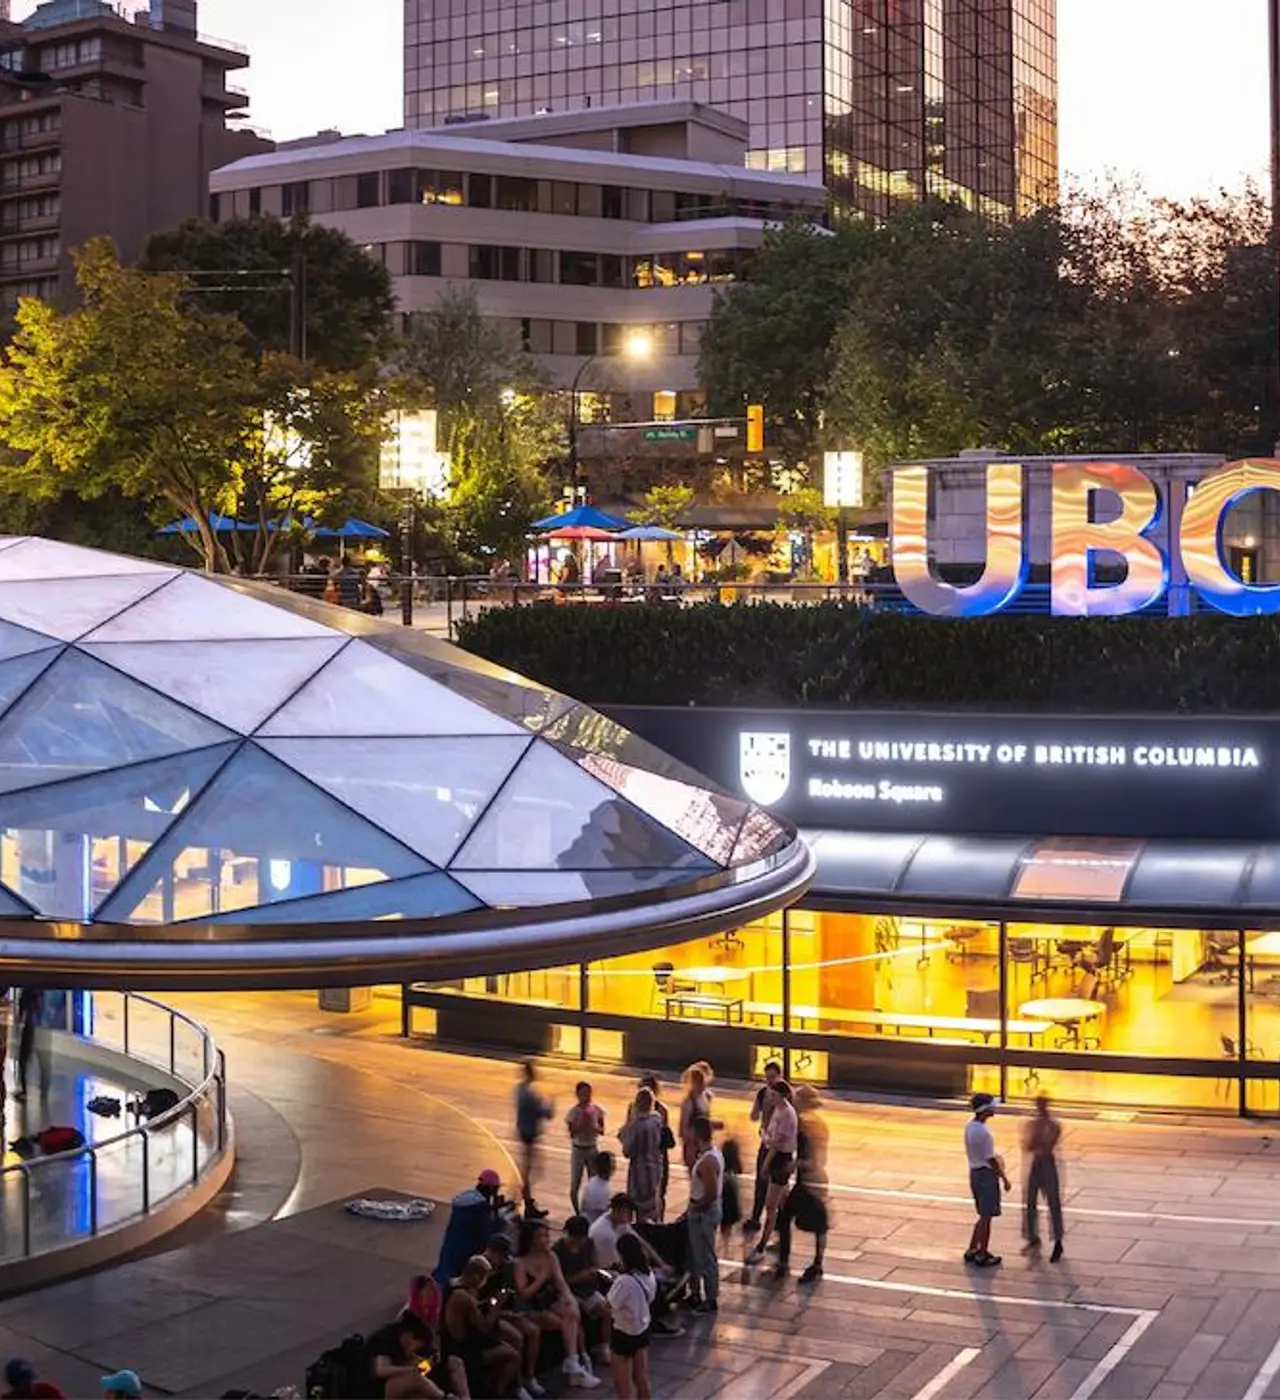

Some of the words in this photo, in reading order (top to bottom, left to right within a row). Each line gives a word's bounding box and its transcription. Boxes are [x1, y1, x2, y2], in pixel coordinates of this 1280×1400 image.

[808, 739, 851, 759] THE
[858, 741, 991, 762] UNIVERSITY
[997, 744, 1027, 763] OF
[1034, 745, 1126, 765] BRITISH
[1133, 746, 1259, 767] COLUMBIA
[808, 778, 876, 800] Robson
[878, 780, 943, 804] Square
